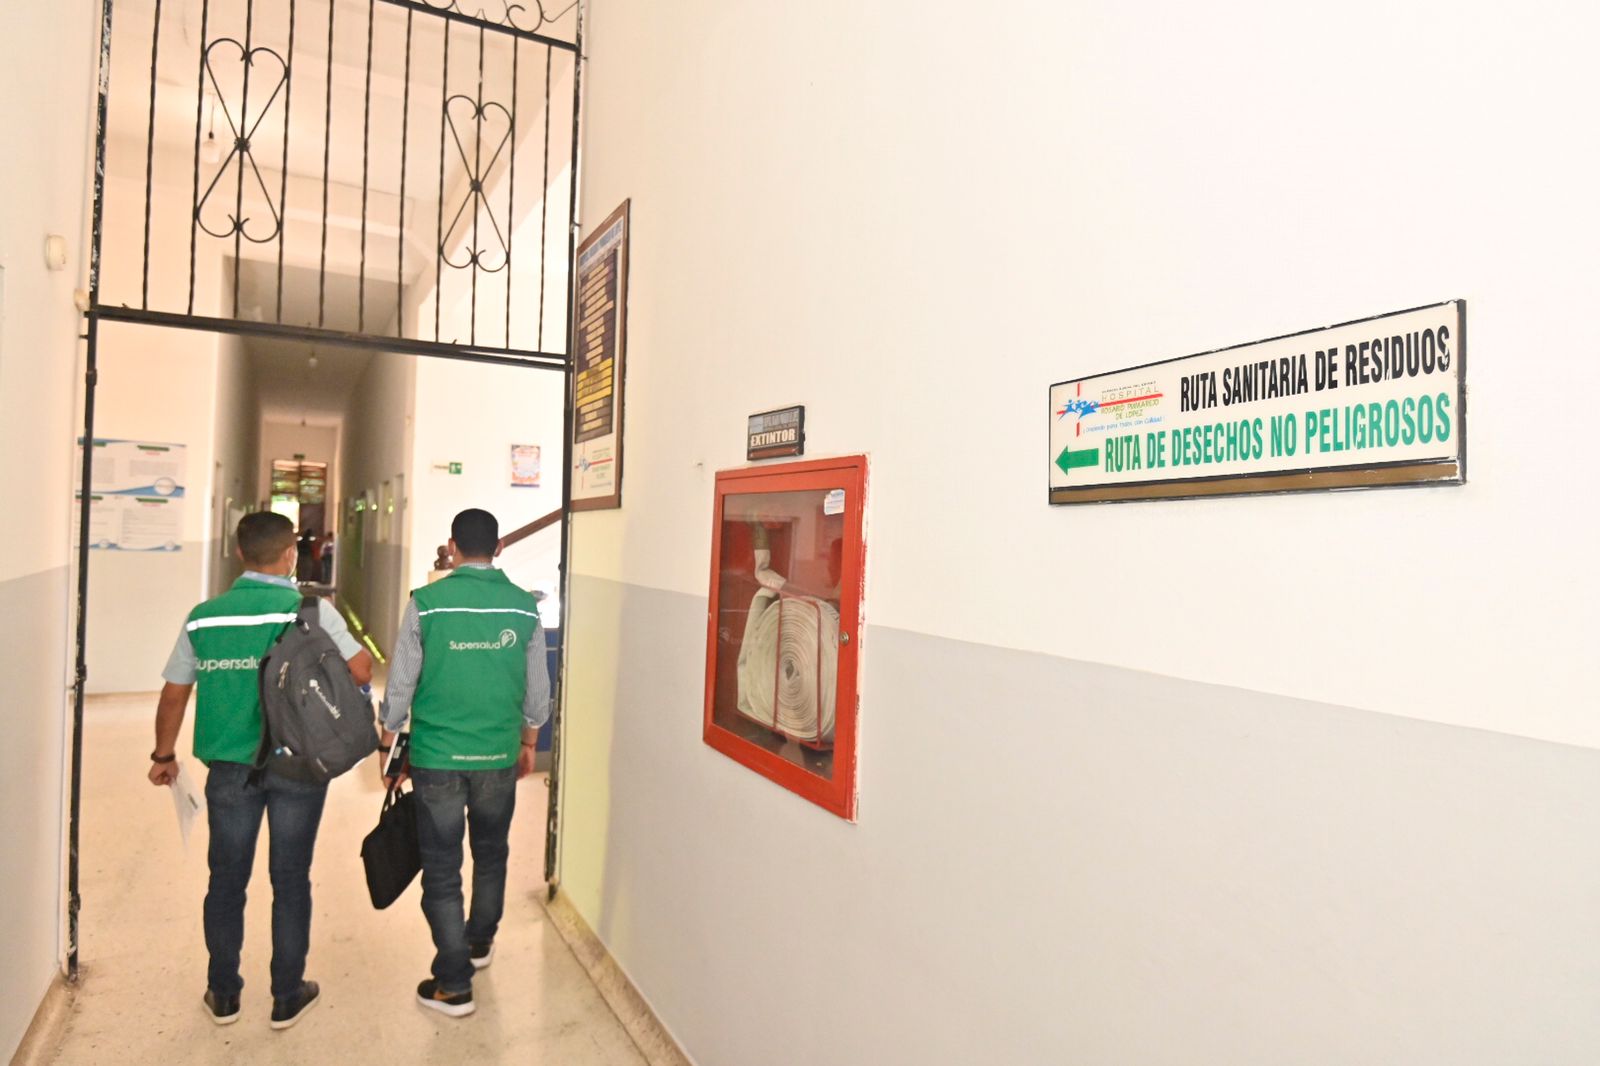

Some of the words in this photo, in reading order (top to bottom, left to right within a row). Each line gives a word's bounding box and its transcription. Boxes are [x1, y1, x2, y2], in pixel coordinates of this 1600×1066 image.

[1180, 371, 1218, 412] RUTA
[1222, 353, 1308, 406] SANITARIA
[1315, 347, 1338, 391] DE
[1345, 325, 1450, 387] RESIDUOS
[1101, 386, 1159, 402] HOSPITAL
[751, 428, 796, 447] EXTINTOR
[1105, 434, 1142, 473] RUTA
[1147, 430, 1166, 469] DE
[1172, 417, 1263, 466] DESECHOS
[1271, 413, 1297, 458] NO
[1305, 392, 1451, 454] PELIGROSOS
[449, 640, 501, 652] Supersalud
[195, 655, 261, 672] upersalu
